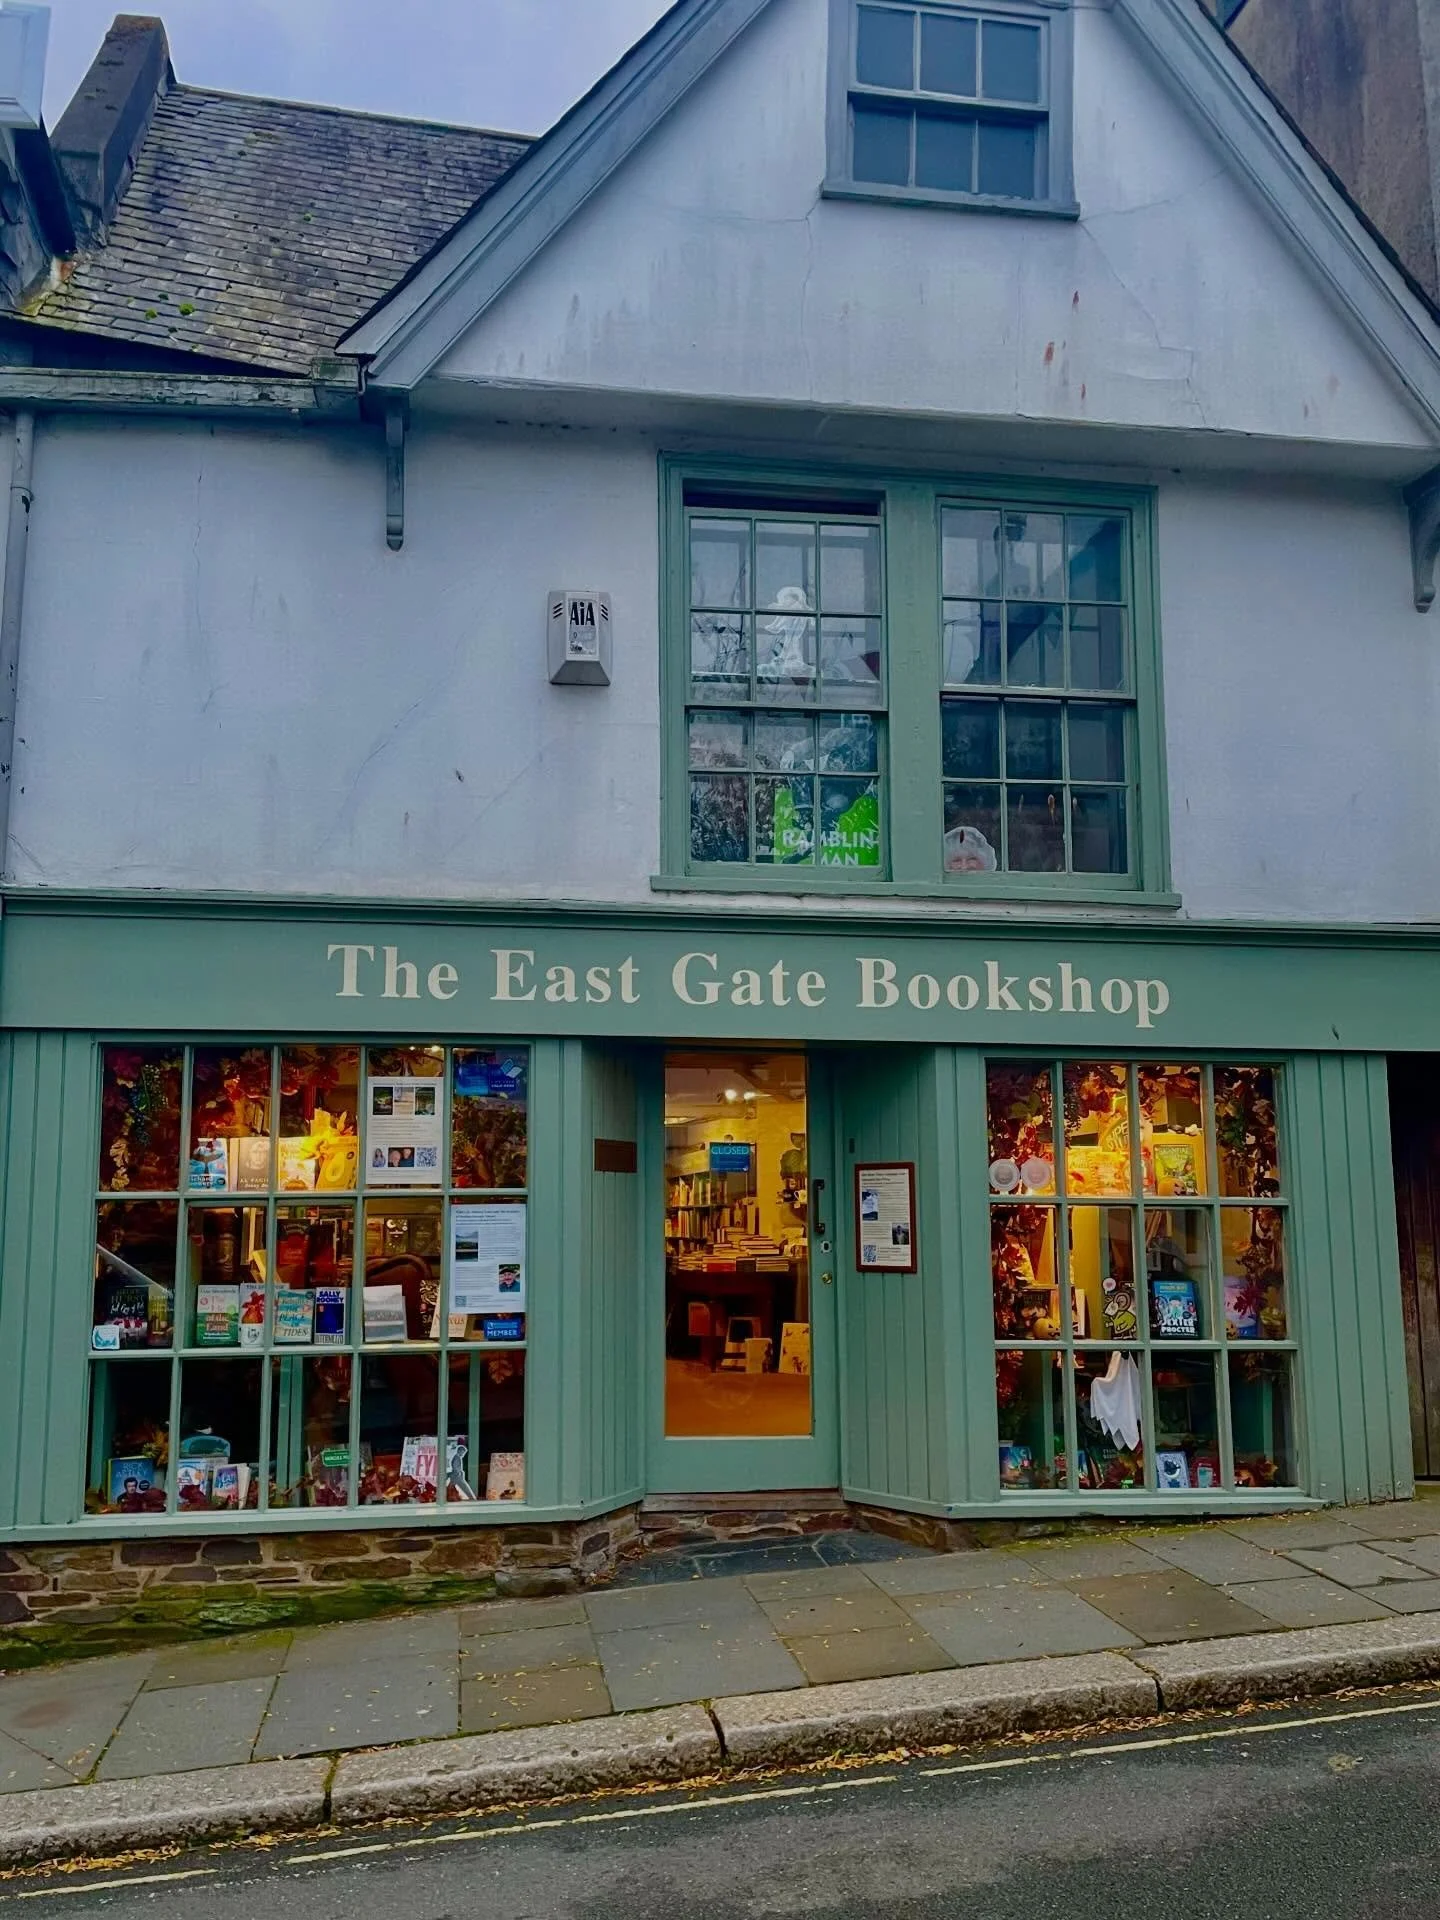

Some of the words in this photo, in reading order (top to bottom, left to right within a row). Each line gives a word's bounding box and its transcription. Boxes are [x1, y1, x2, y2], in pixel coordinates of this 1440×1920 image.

[570, 601, 595, 626] AiA
[783, 830, 877, 848] RAMBLIN
[327, 944, 459, 1000] The
[490, 949, 641, 1003] East
[672, 952, 826, 1007] Gate
[855, 957, 1170, 1028] Bookshop
[711, 1146, 749, 1155] CLOSED
[486, 1329, 518, 1337] MEMBER
[1161, 1326, 1196, 1334] PROCTER
